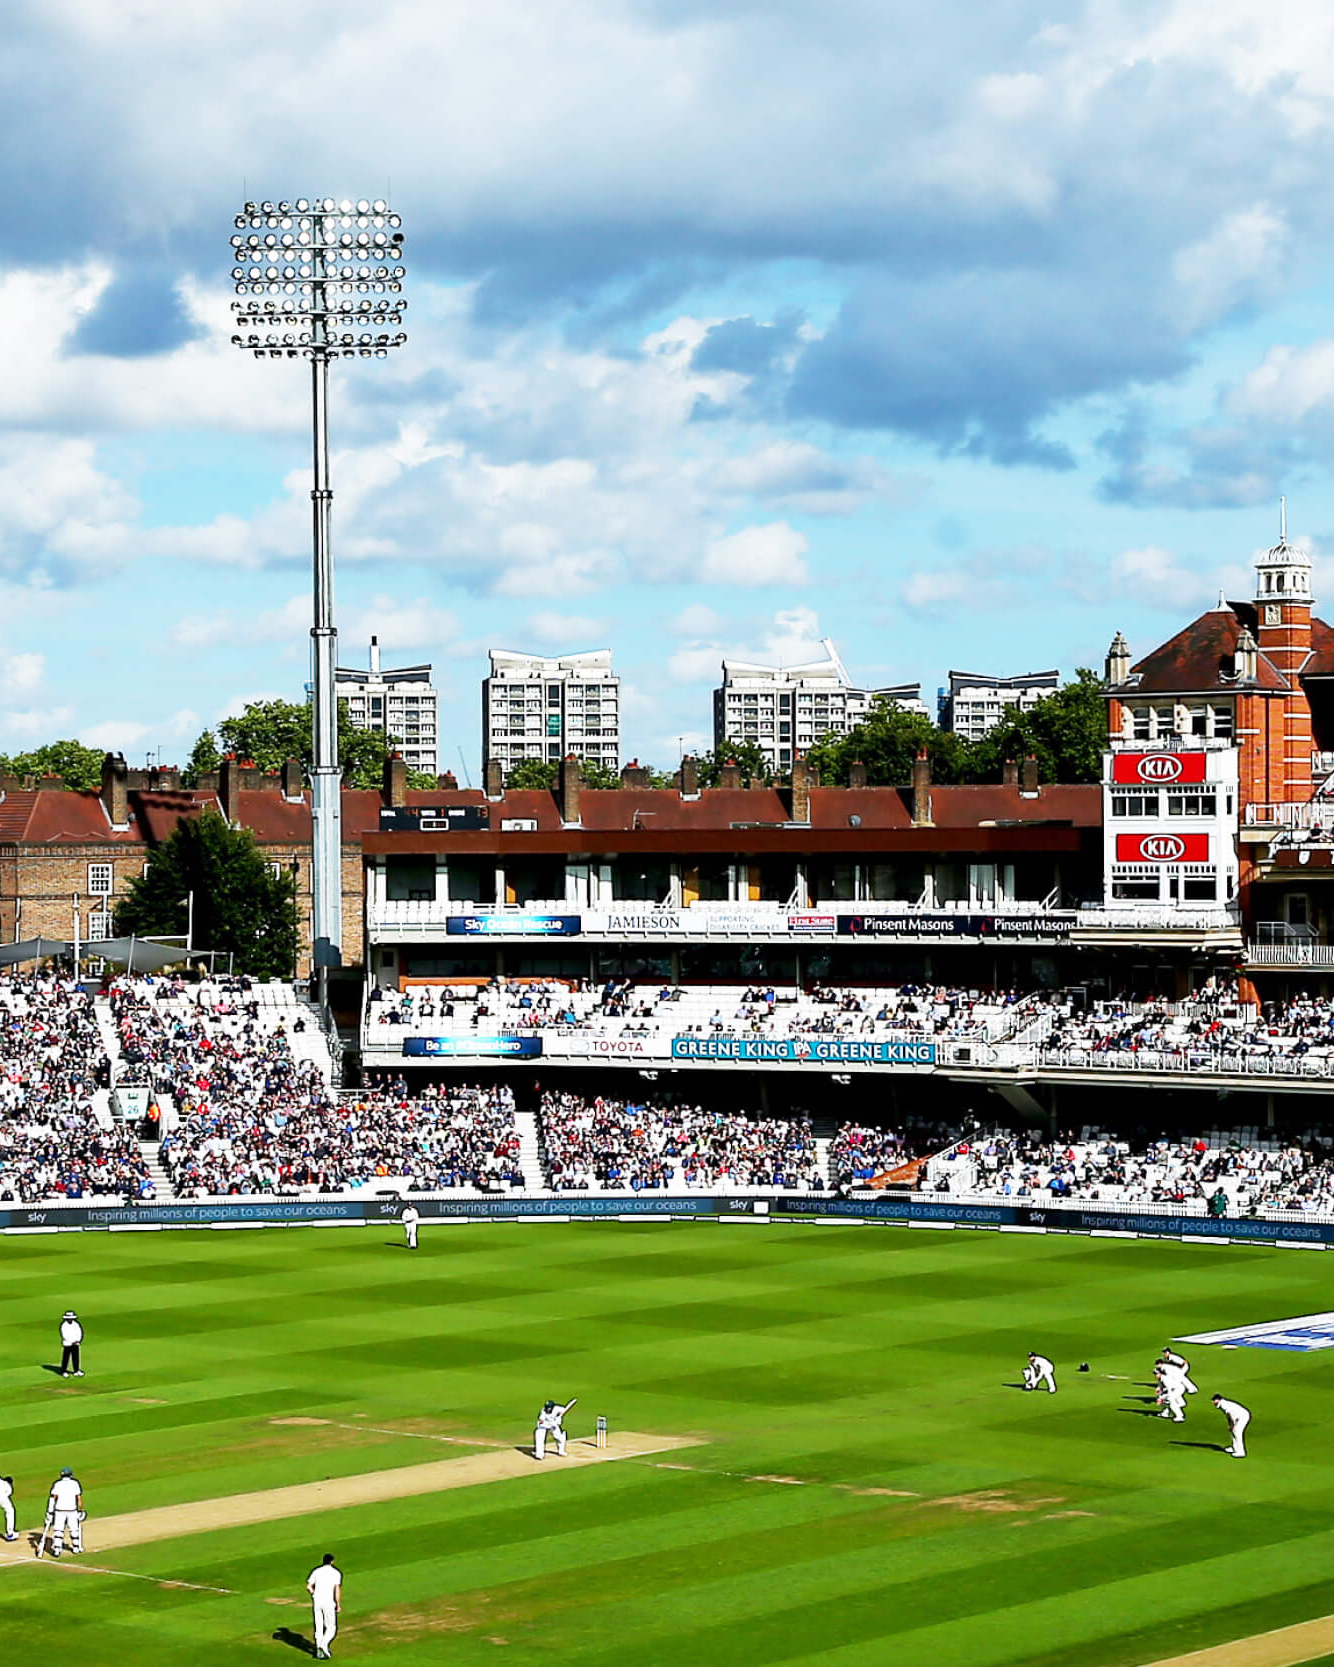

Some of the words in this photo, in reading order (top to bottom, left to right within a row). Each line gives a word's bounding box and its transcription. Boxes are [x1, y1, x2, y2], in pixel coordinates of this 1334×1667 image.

[1145, 760, 1175, 776] KIA
[1147, 840, 1178, 856] KIA
[464, 918, 485, 931] Sky
[607, 915, 681, 930] JAMIESON
[863, 917, 906, 931] Pinsent
[907, 918, 954, 931] Masons
[993, 917, 1033, 931] Pinsent
[1034, 918, 1076, 932] Masons
[426, 1040, 440, 1051] Be
[592, 1041, 643, 1052] TOYOTA
[675, 1041, 741, 1057] GREENE
[746, 1042, 788, 1058] KING
[793, 1041, 812, 1055] IPA
[816, 1043, 882, 1059] GREENE
[888, 1045, 930, 1060] KING
[379, 1203, 399, 1215] sky
[439, 1203, 489, 1215] Inspiring
[490, 1201, 533, 1212] millions
[535, 1201, 549, 1212] of
[550, 1200, 589, 1215] people
[591, 1201, 604, 1211] to
[605, 1202, 633, 1211] save
[635, 1201, 655, 1210] our
[657, 1200, 696, 1210] oceans
[730, 1200, 748, 1212] sky
[787, 1199, 827, 1213] Inspiring
[828, 1201, 862, 1214] millions
[865, 1203, 875, 1214] of
[876, 1204, 909, 1218] people
[911, 1206, 922, 1216] to
[923, 1208, 947, 1217] save
[948, 1208, 965, 1218] our
[966, 1209, 1000, 1220] oceans
[27, 1211, 47, 1224] sky
[87, 1209, 137, 1223] Inspiring
[140, 1206, 182, 1219] millions
[184, 1206, 198, 1218] of
[199, 1205, 239, 1220] people
[241, 1206, 254, 1217] to
[255, 1207, 283, 1217] save
[284, 1206, 305, 1216] our
[307, 1205, 347, 1216] oceans
[1030, 1212, 1046, 1225] sky
[1082, 1213, 1125, 1230] Inspiring
[1126, 1215, 1166, 1229] millions
[1168, 1217, 1180, 1230] of
[1181, 1219, 1218, 1236] people
[1221, 1221, 1233, 1233] to
[1235, 1224, 1260, 1234] save
[1262, 1225, 1281, 1236] our
[1282, 1226, 1321, 1238] oceans
